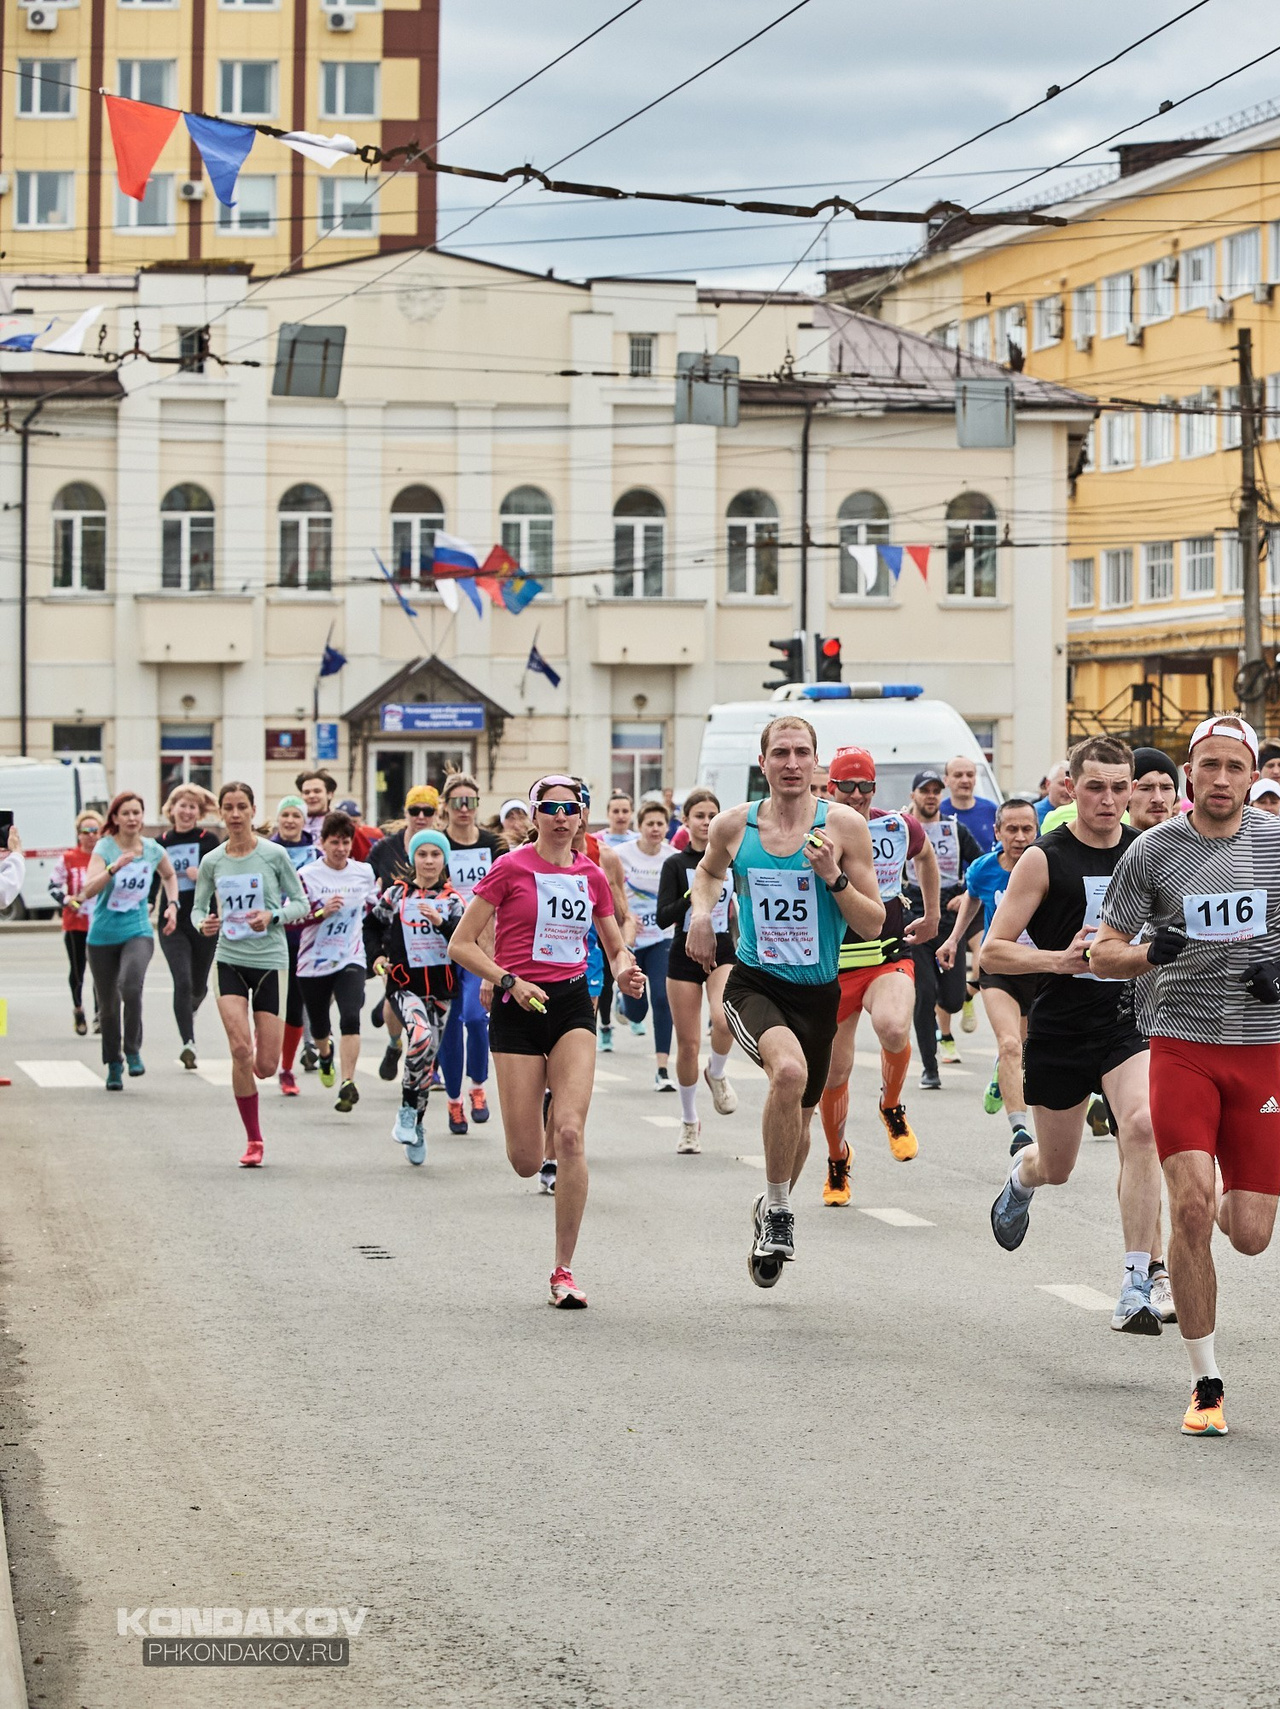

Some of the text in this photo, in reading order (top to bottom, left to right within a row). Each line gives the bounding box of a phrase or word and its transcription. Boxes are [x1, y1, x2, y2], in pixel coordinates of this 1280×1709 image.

[457, 867, 487, 882] 149
[226, 894, 256, 910] 117
[547, 896, 586, 922] 192
[759, 898, 808, 922] 125
[1197, 896, 1254, 927] 116
